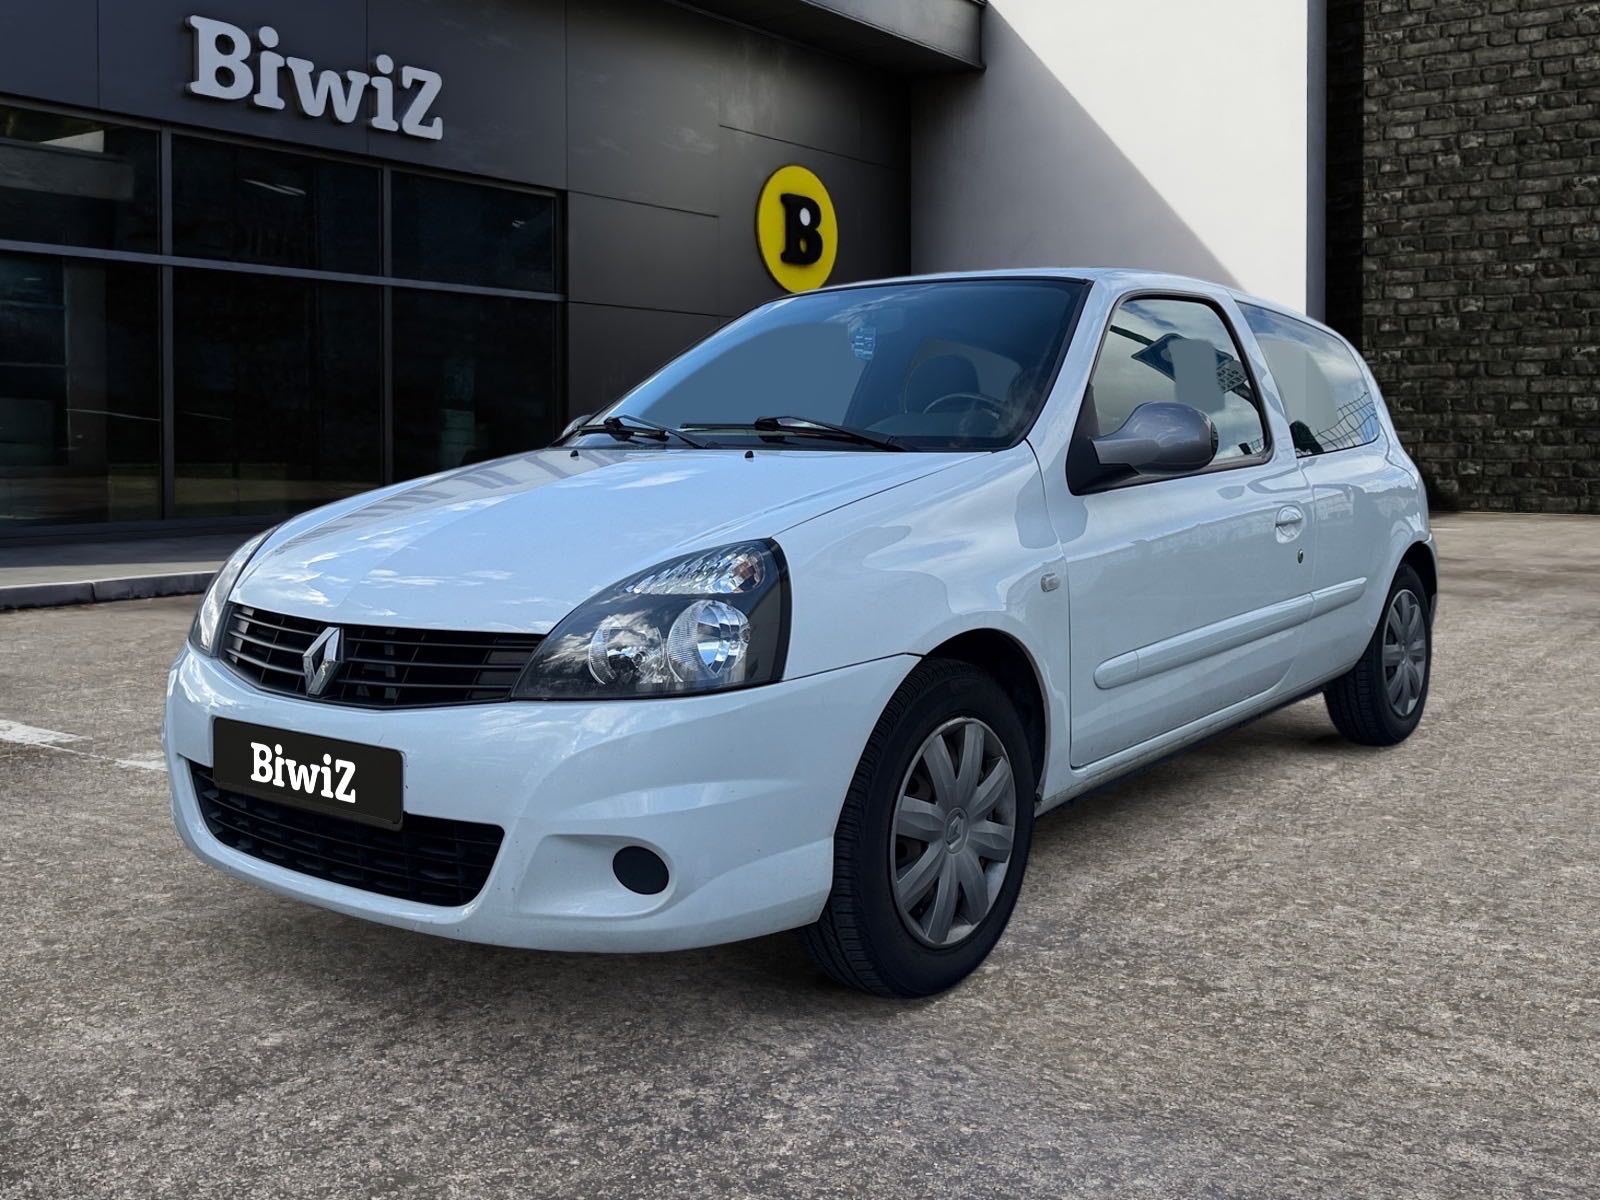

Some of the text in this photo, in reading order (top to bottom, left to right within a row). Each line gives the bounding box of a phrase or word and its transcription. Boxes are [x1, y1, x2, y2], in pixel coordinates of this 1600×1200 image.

[189, 15, 443, 140] BiwiZ
[780, 193, 823, 265] B
[251, 742, 356, 803] BiwiZ
